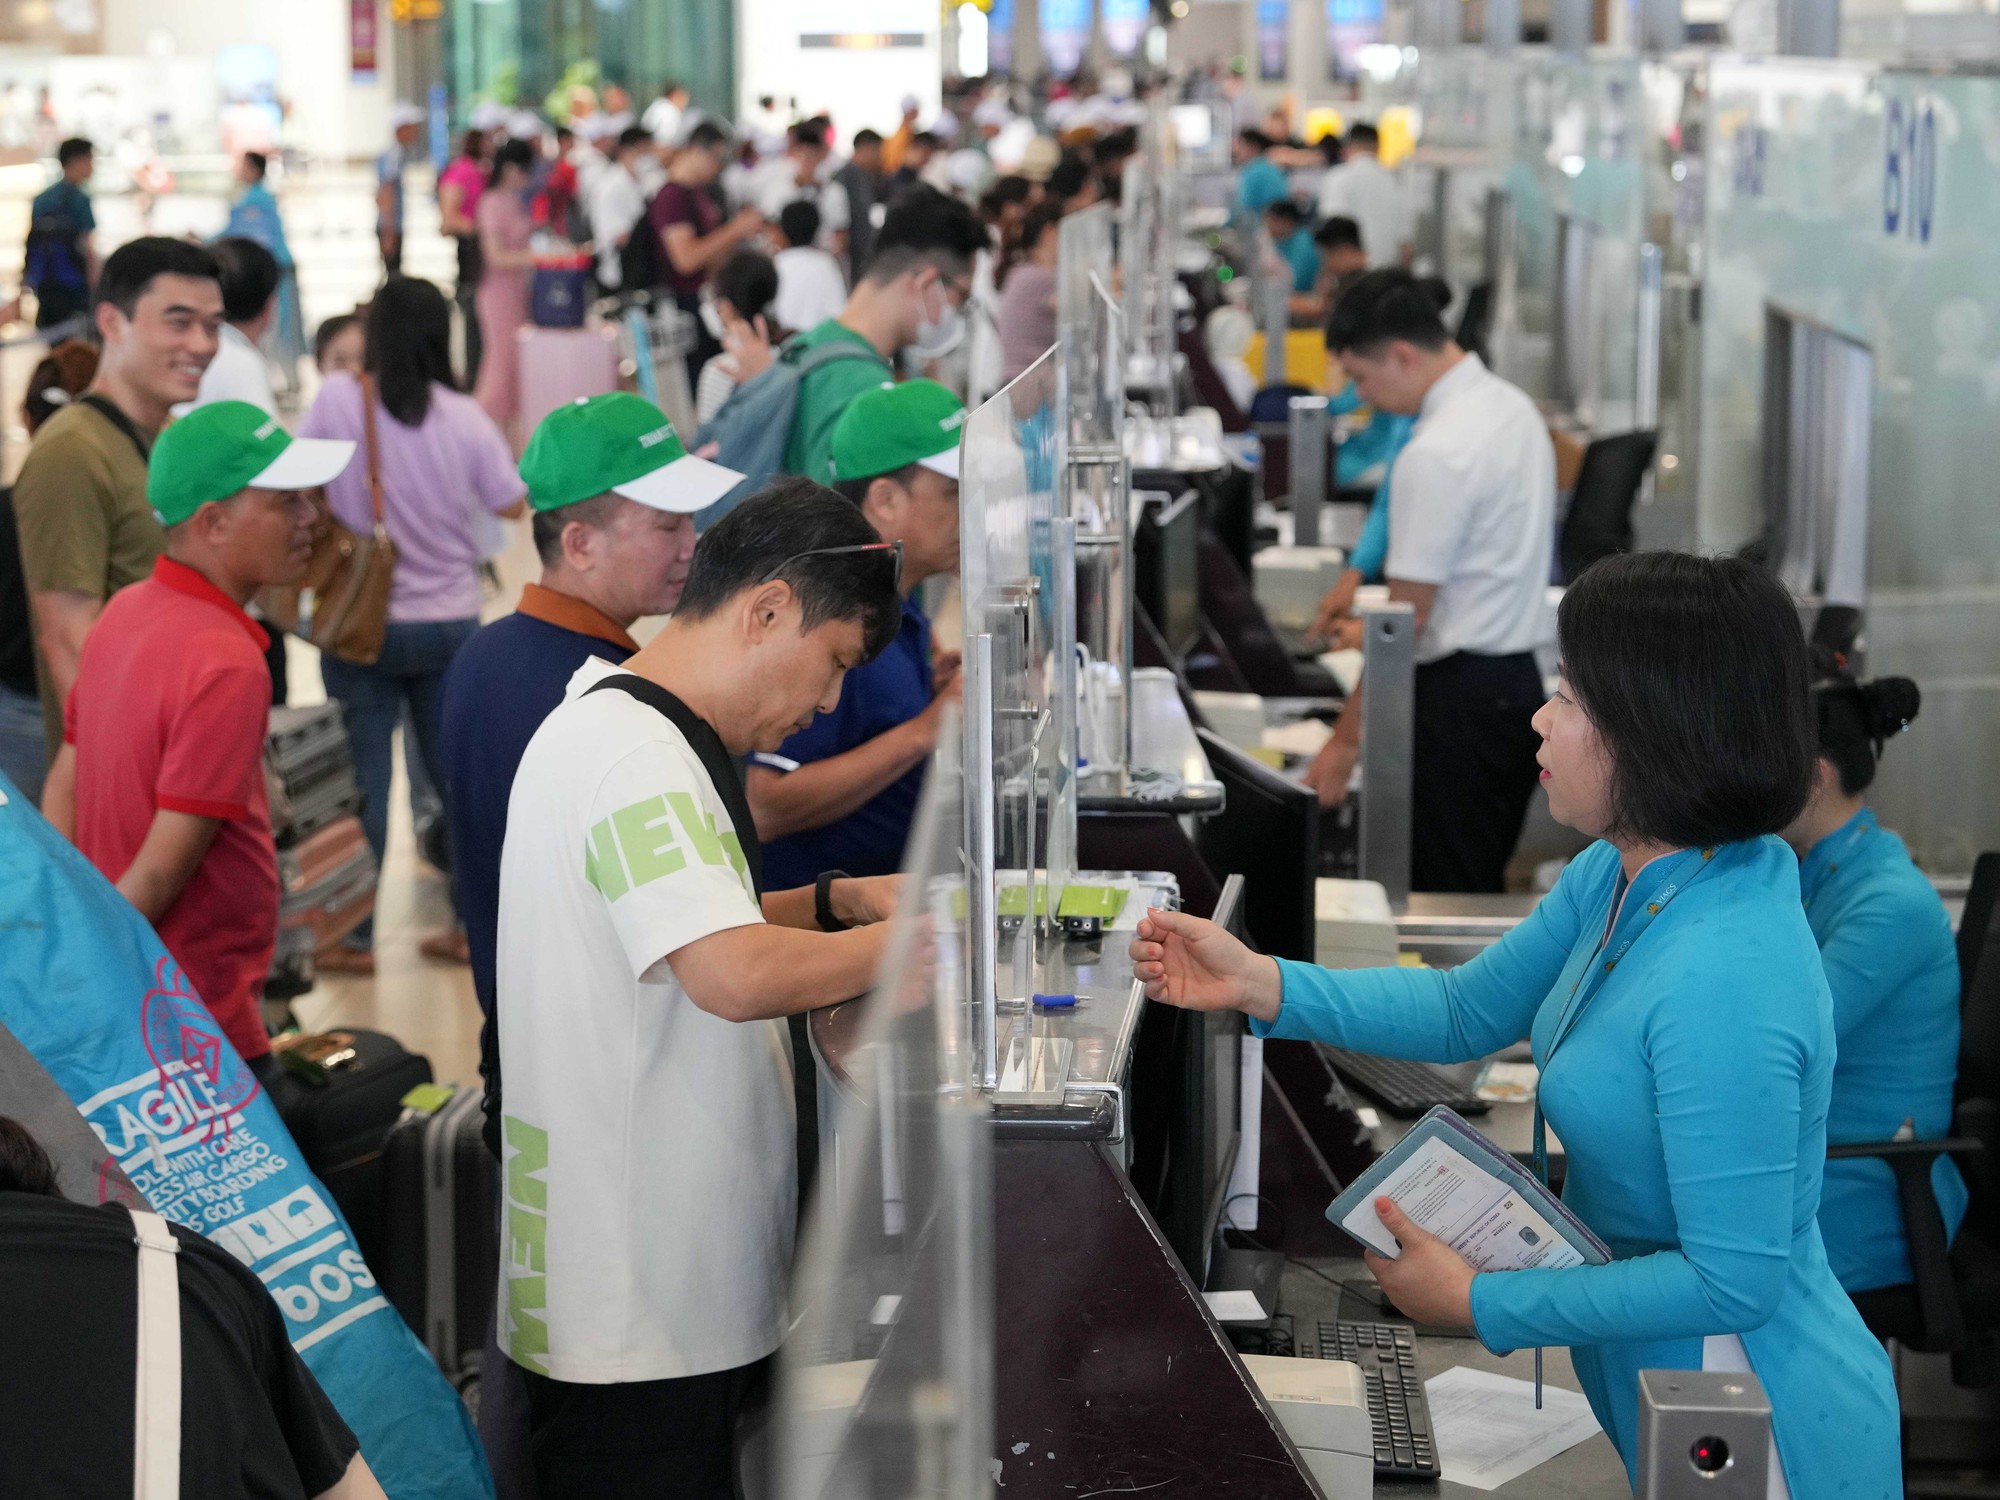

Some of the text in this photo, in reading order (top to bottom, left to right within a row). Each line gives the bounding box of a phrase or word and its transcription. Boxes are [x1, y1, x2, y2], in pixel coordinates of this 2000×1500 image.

[1655, 882, 1678, 905] VIAGS
[167, 1145, 215, 1174] WITH
[210, 1127, 259, 1158] CARE
[183, 1170, 212, 1189] AIR
[206, 1141, 271, 1181] CARGO
[196, 1154, 289, 1204] BOARDING
[202, 1194, 246, 1224] GOLF
